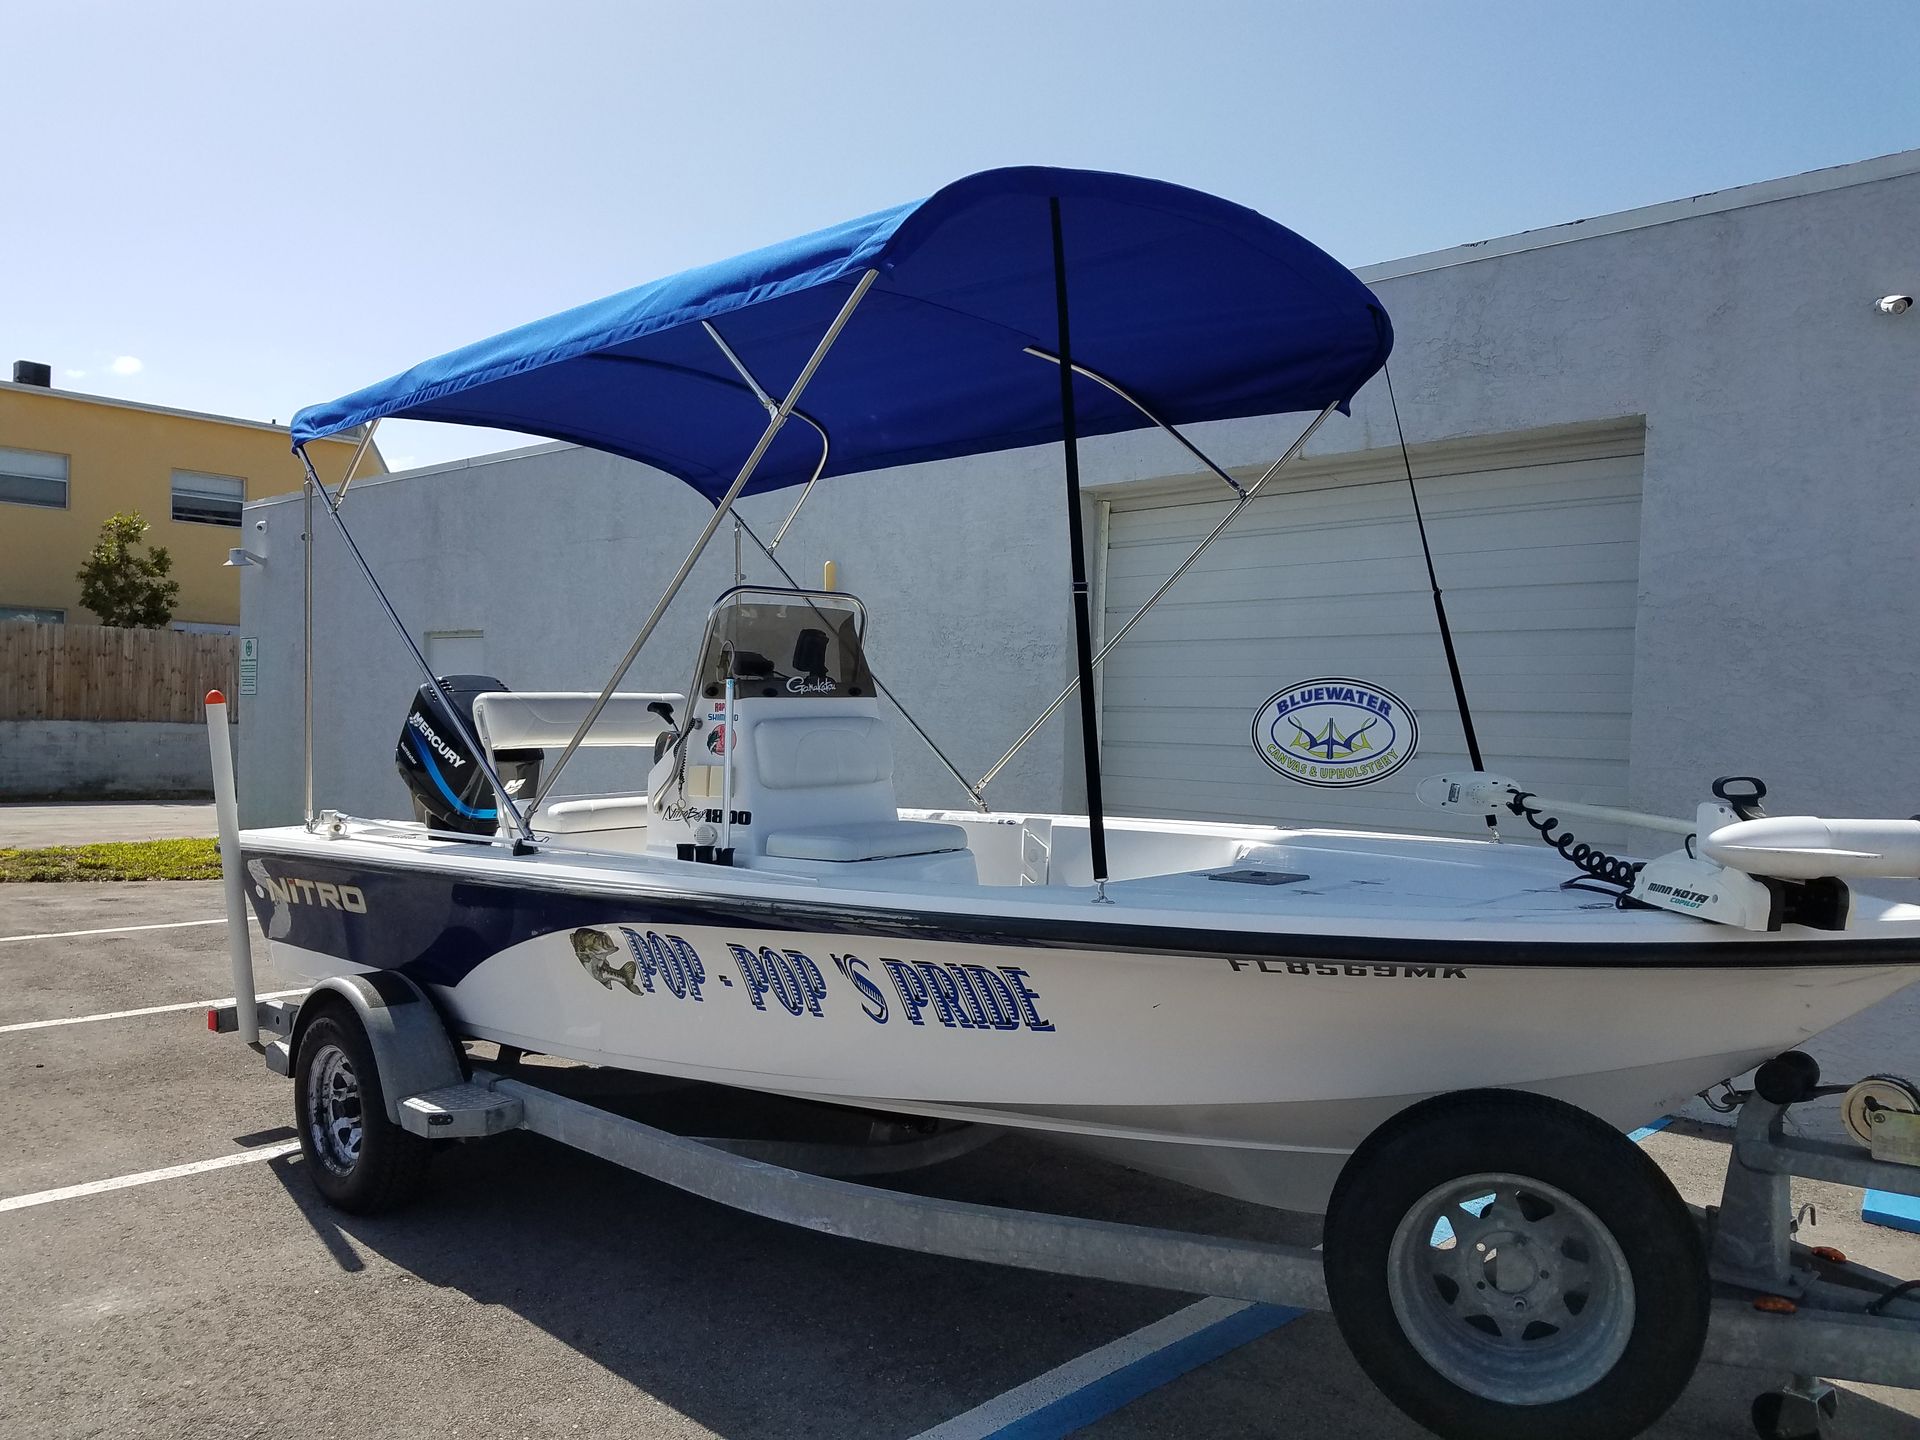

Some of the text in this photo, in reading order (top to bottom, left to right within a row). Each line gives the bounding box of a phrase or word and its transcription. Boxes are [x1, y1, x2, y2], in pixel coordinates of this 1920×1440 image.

[1276, 687, 1392, 717] BLUEWATER
[409, 711, 466, 768] MERCURY
[1266, 743, 1399, 780] CANVAS & UPHOLSTERY
[1670, 897, 1703, 909] COPILOT
[1672, 888, 1710, 904] KOTA
[619, 926, 706, 1002] POP
[879, 957, 1056, 1032] PRIDE
